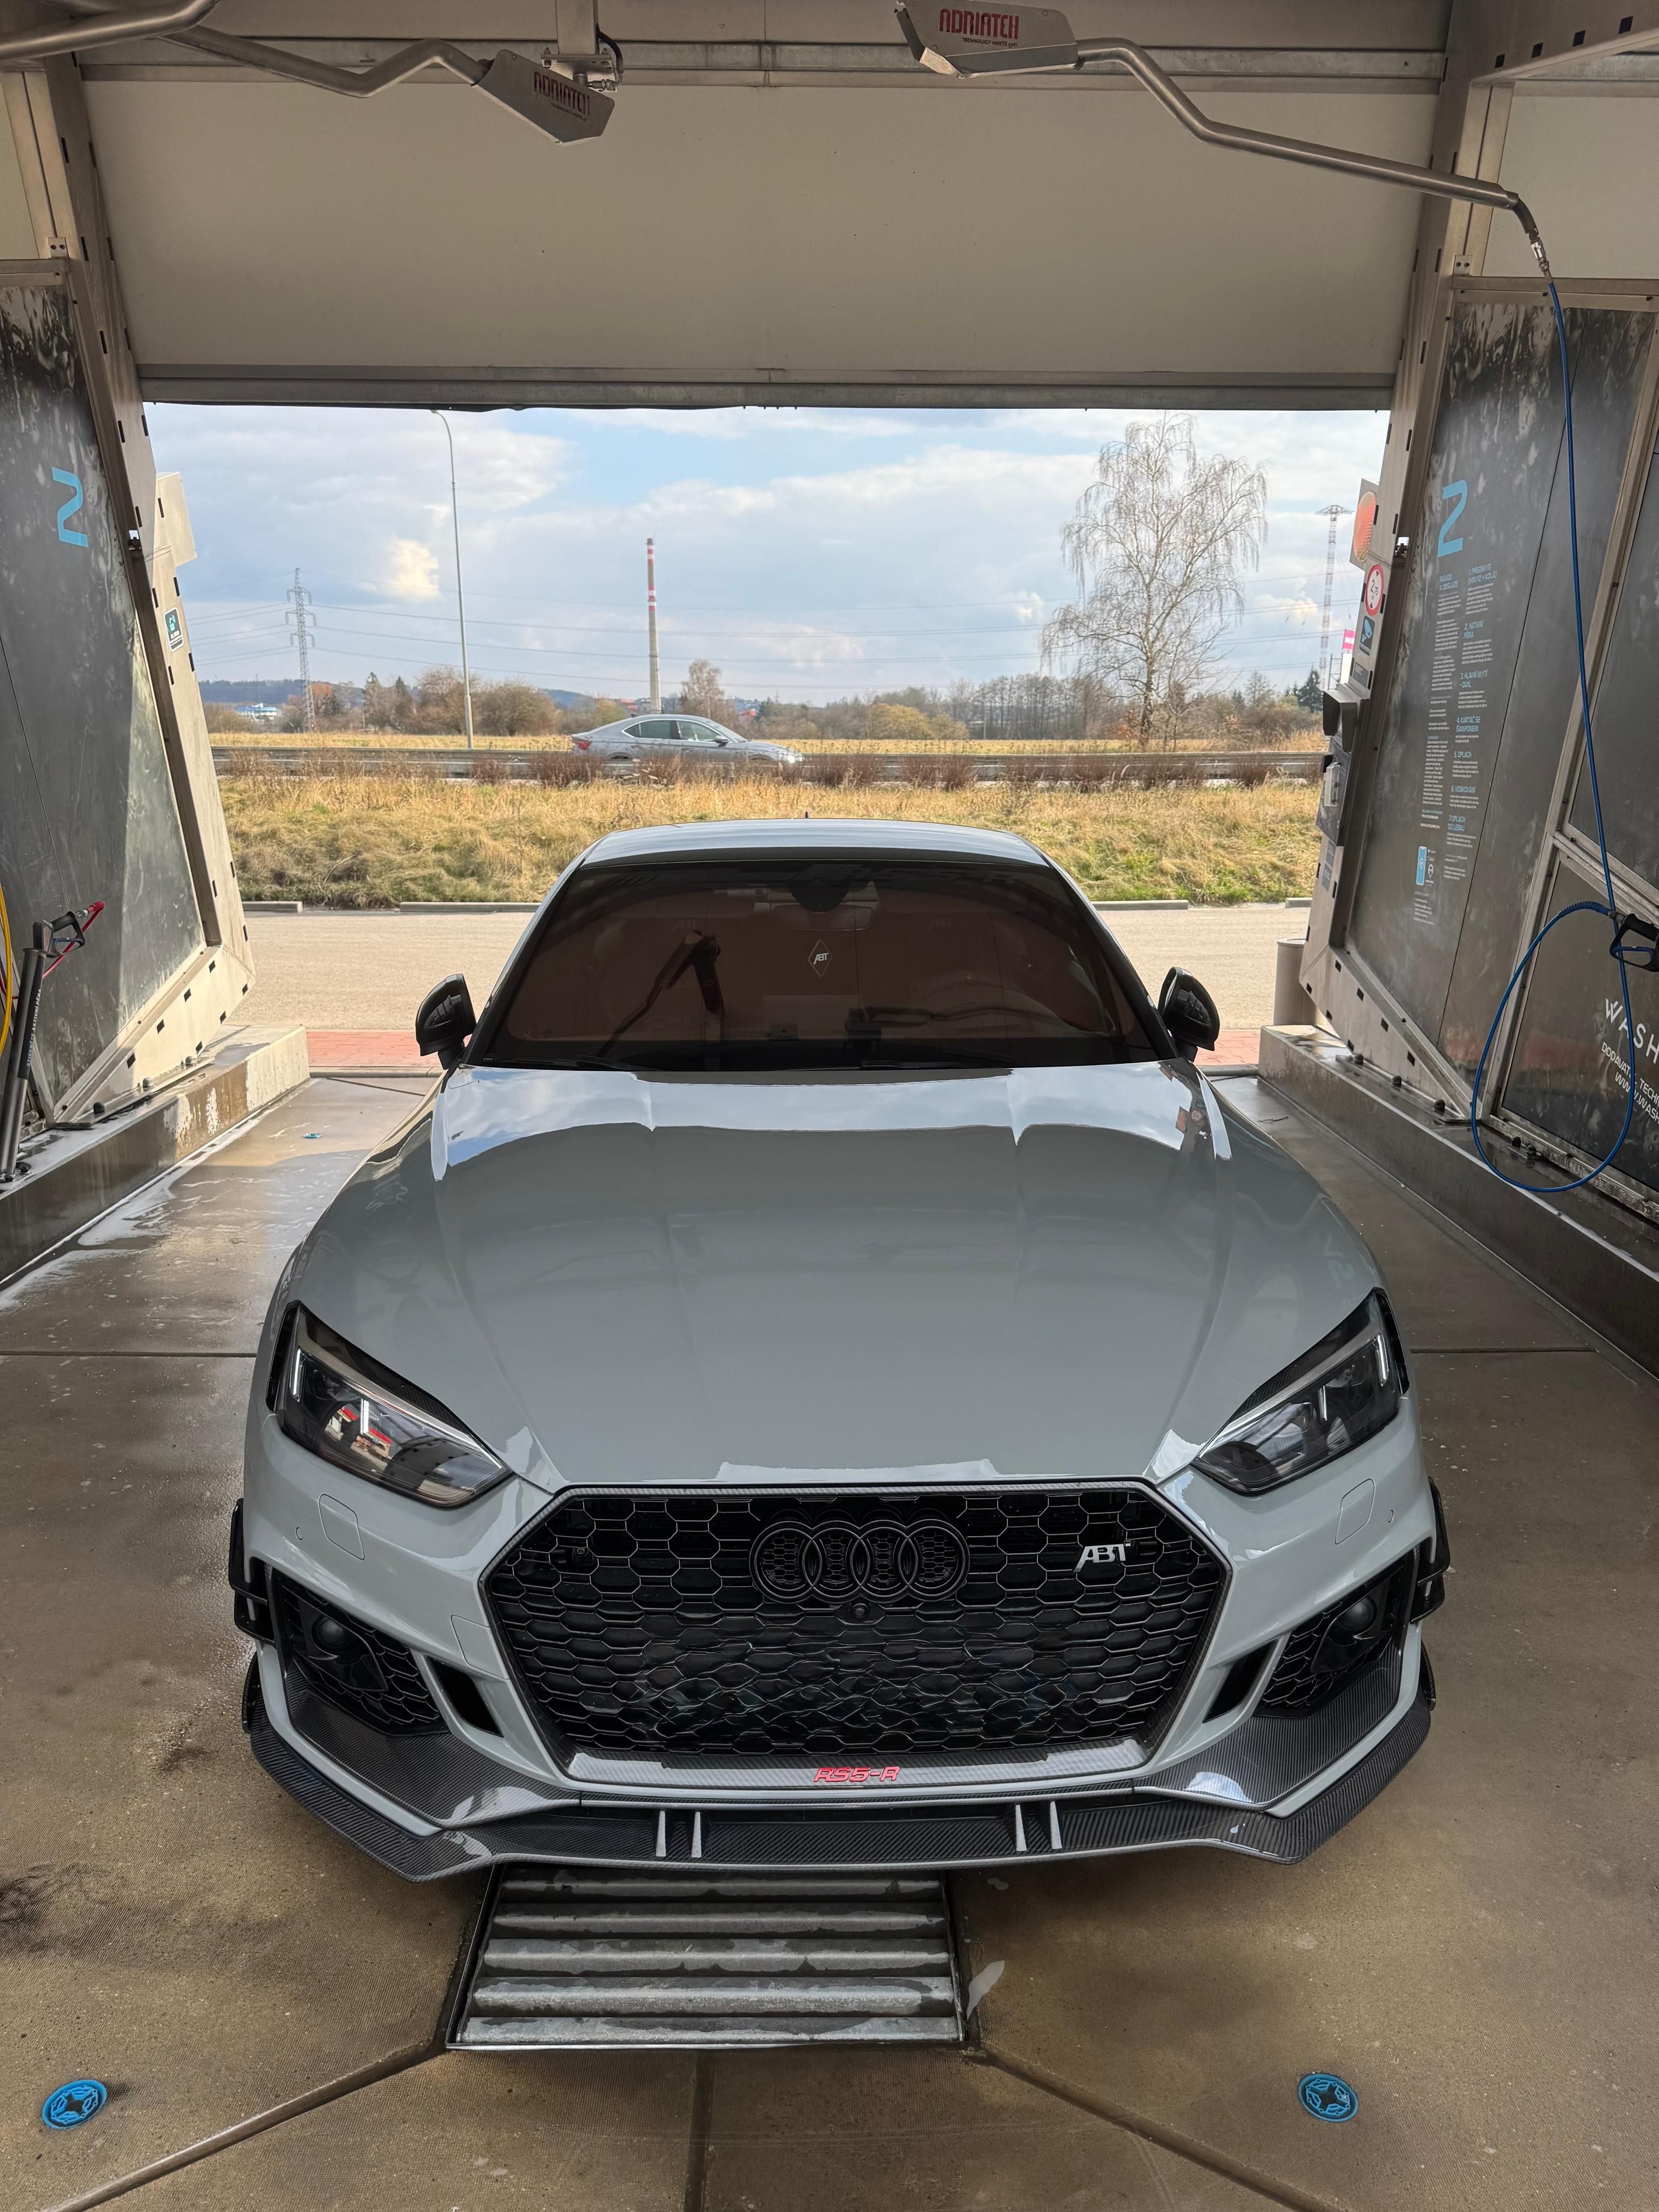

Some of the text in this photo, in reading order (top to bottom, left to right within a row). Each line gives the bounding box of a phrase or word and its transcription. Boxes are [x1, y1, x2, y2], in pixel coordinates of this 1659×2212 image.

[51, 467, 89, 548] 2
[1438, 479, 1468, 558] 2
[813, 952, 829, 965] ABT
[1073, 1543, 1131, 1573] ABT
[813, 1766, 901, 1782] RS5-R
